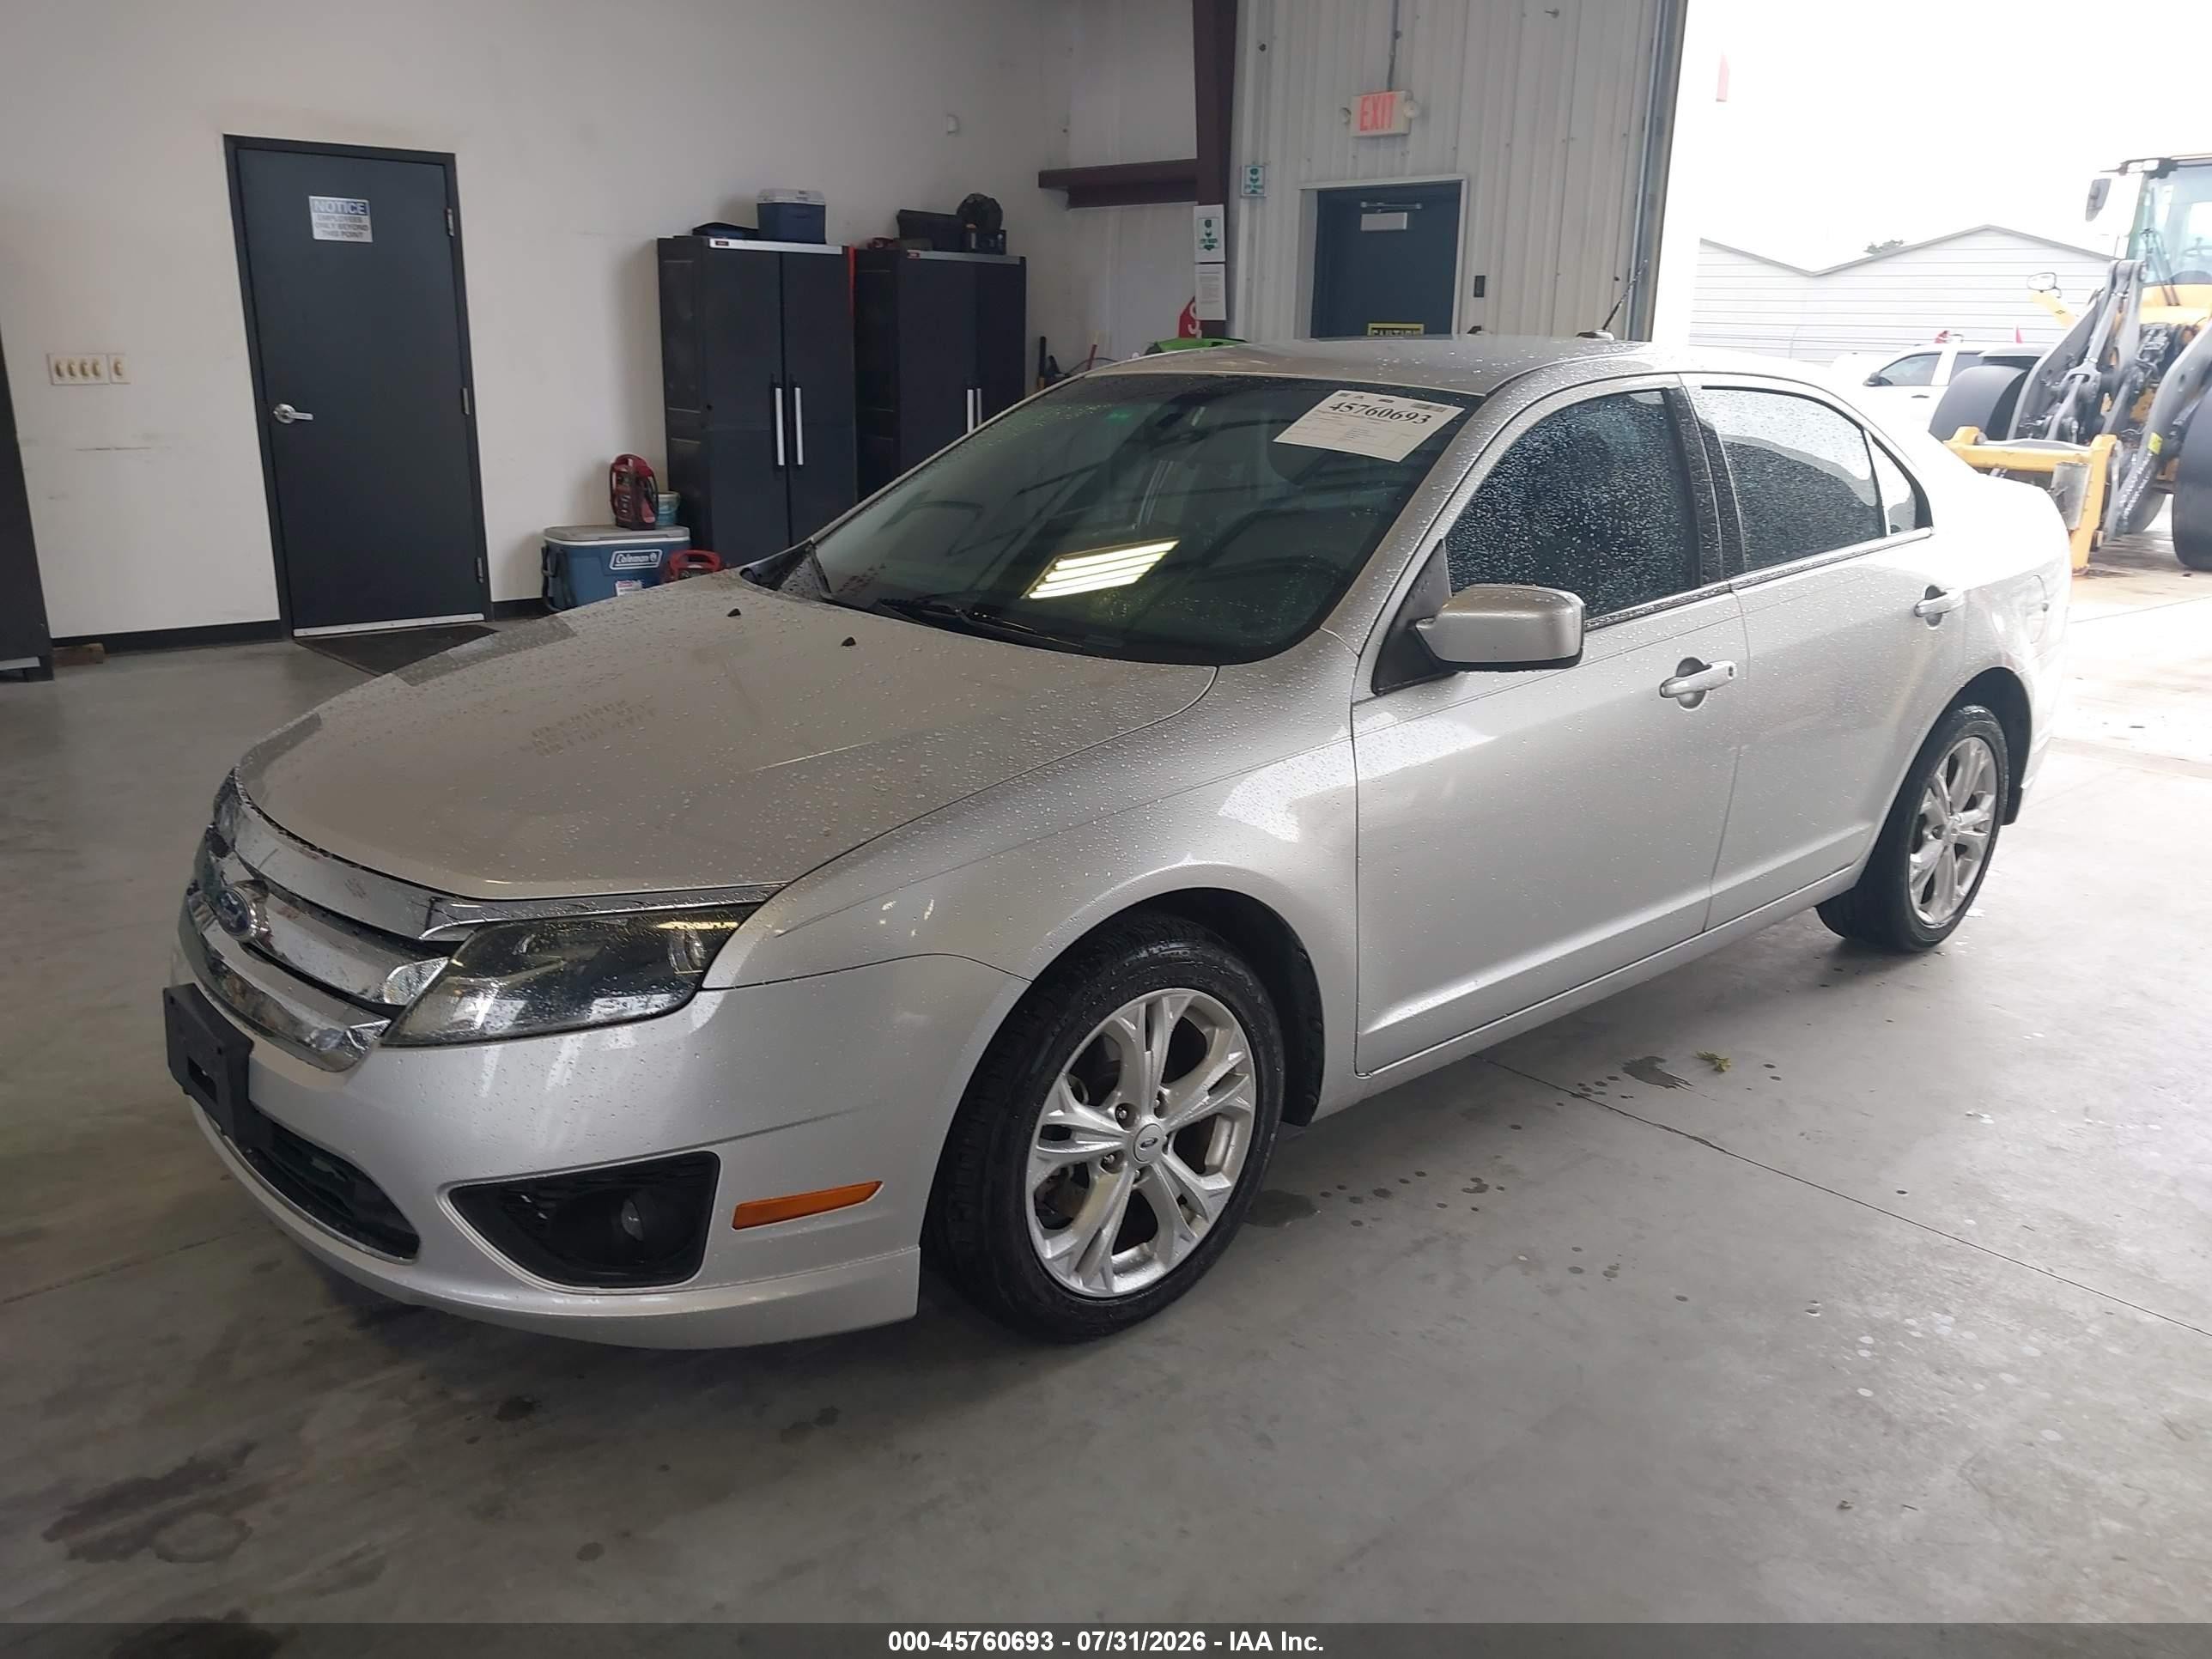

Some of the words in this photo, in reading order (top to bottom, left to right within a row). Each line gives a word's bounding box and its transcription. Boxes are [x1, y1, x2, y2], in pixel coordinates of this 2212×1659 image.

[1359, 94, 1397, 131] EXIT
[313, 200, 366, 215] NOTICE
[1328, 401, 1432, 425] 45760693
[616, 552, 649, 564] Coleman
